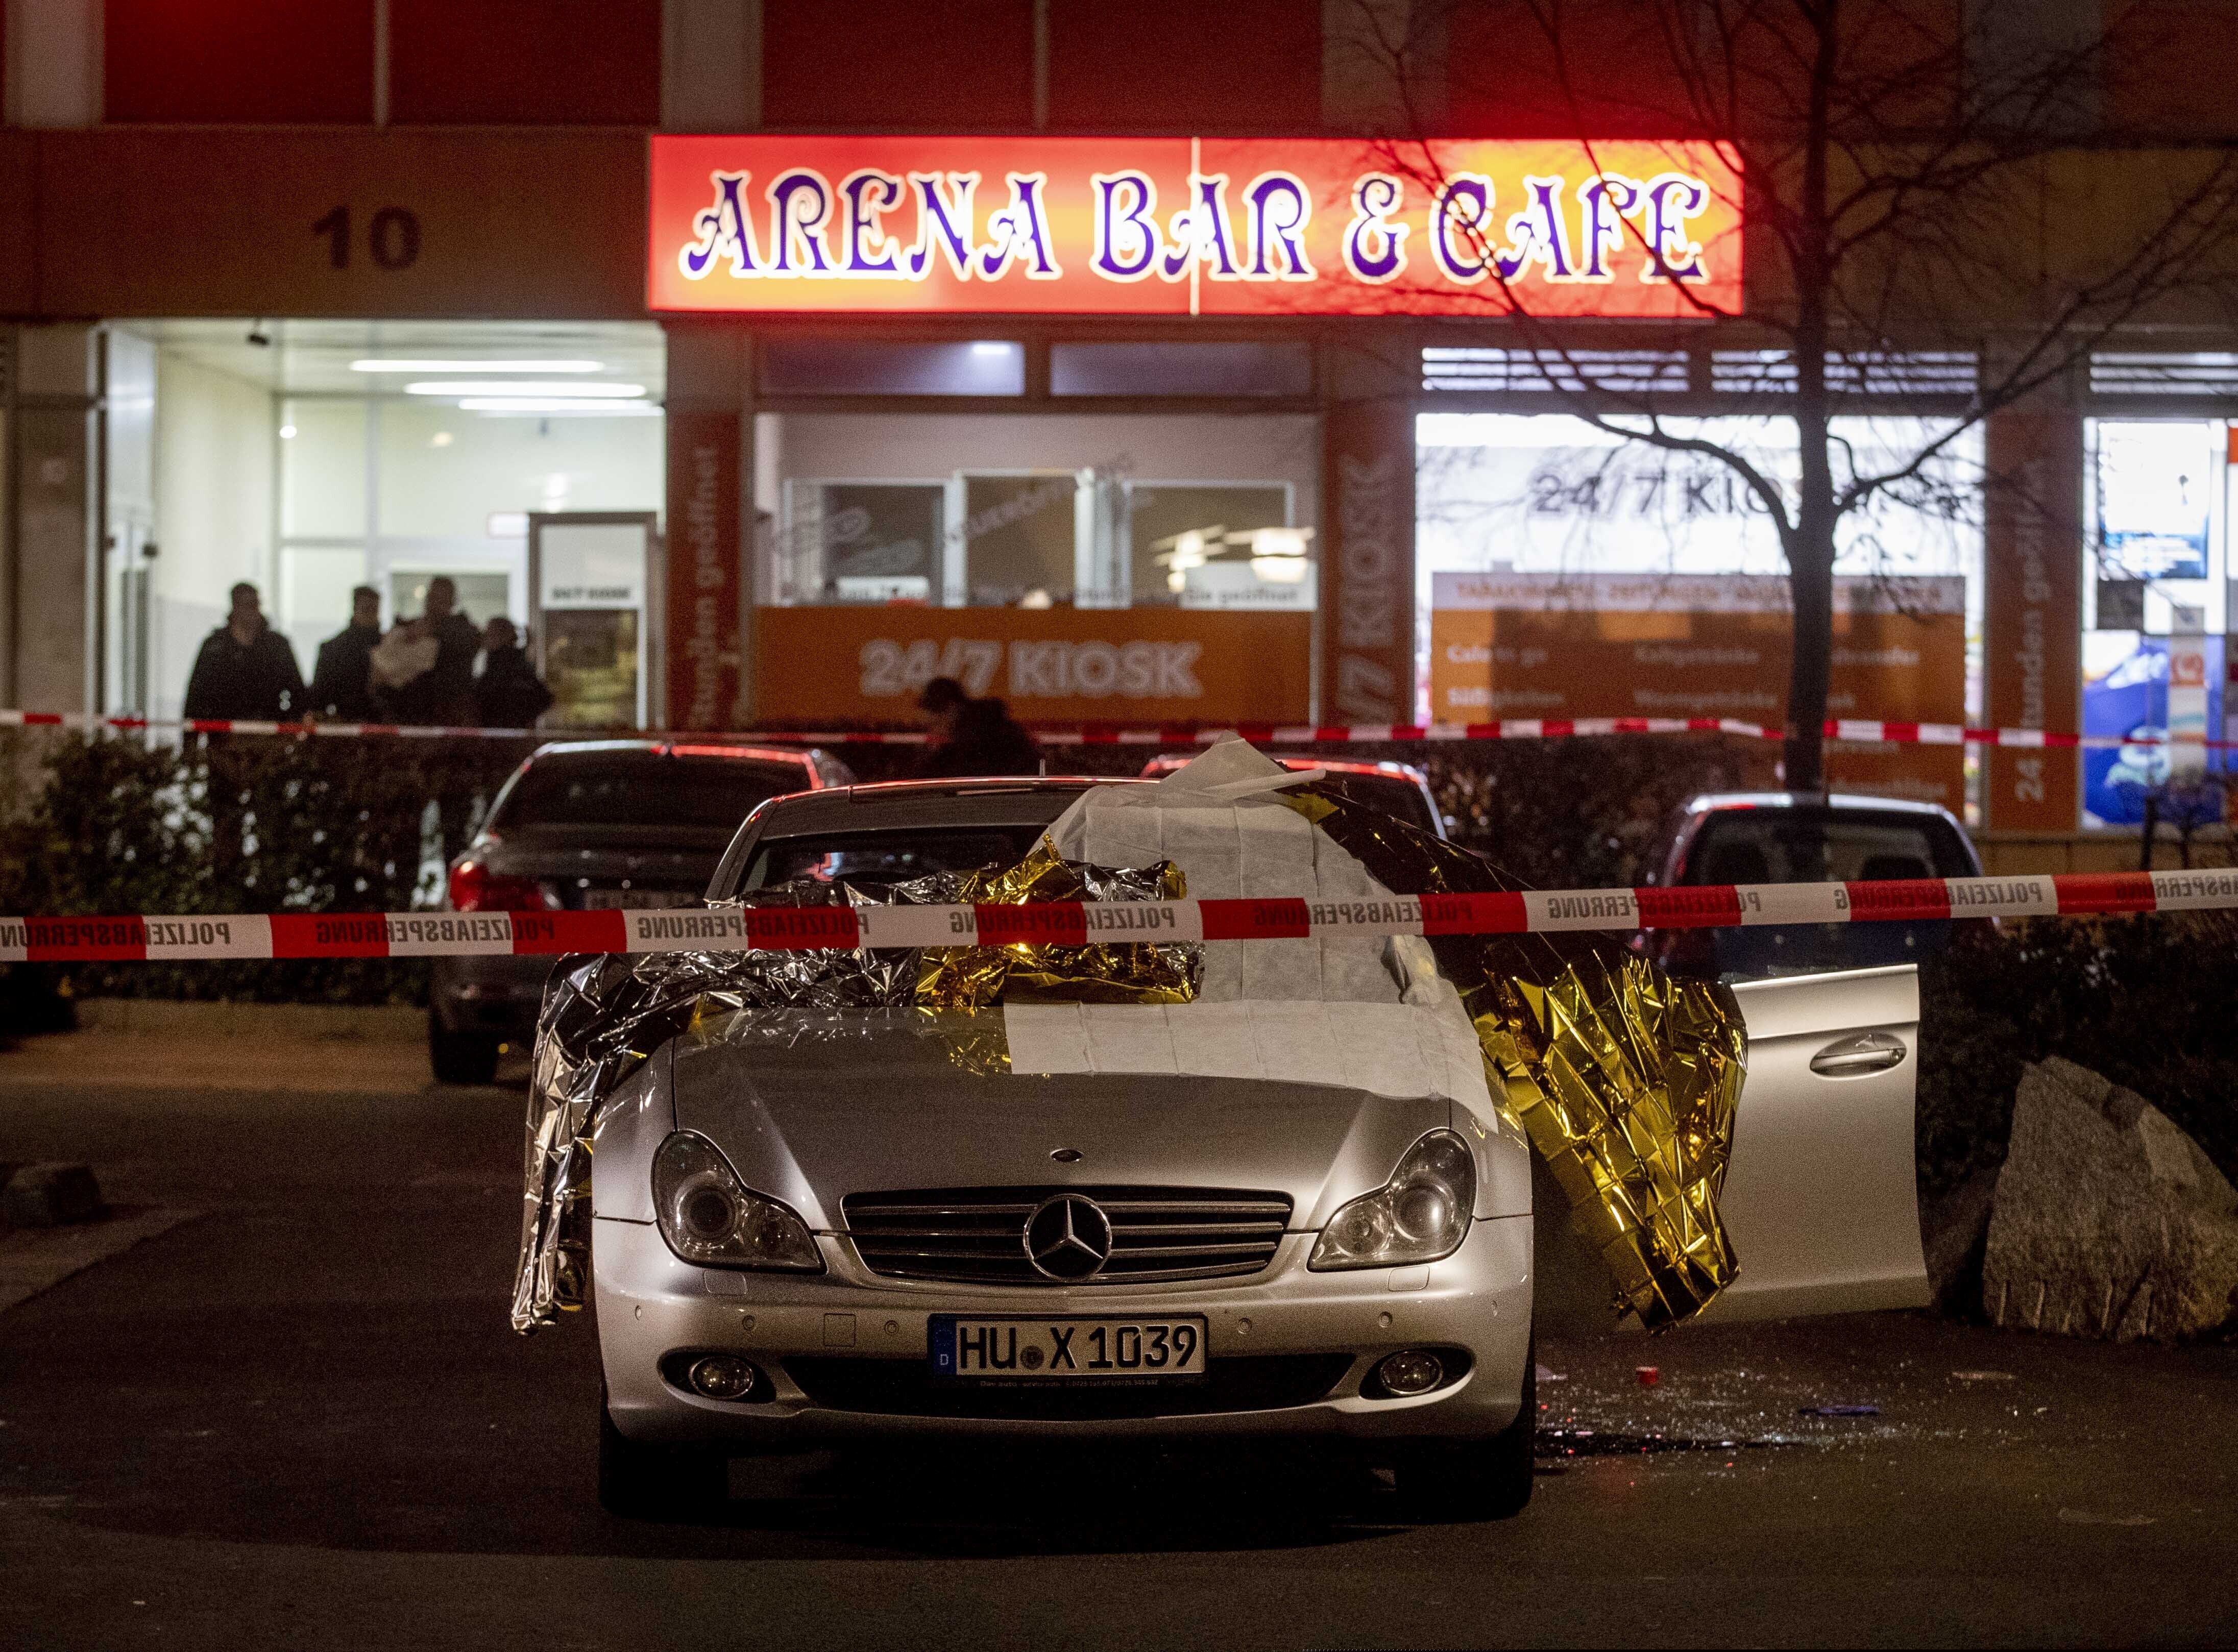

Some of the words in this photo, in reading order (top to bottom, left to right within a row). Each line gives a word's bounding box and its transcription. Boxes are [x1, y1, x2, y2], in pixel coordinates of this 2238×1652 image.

[312, 206, 421, 270] 10
[684, 171, 1058, 278] ARENA
[1095, 172, 1312, 279] BAR
[1347, 176, 1405, 280] &
[1436, 177, 1707, 279] CAFE
[1338, 455, 1395, 649] KIOSK
[859, 638, 1003, 698] 24/7
[1008, 639, 1204, 699] KIOSK
[2014, 609, 2045, 745] tunden
[2015, 758, 2043, 803] 24
[940, 1353, 948, 1365] D
[960, 1327, 1016, 1370] HU
[1087, 1324, 1198, 1369] 1039
